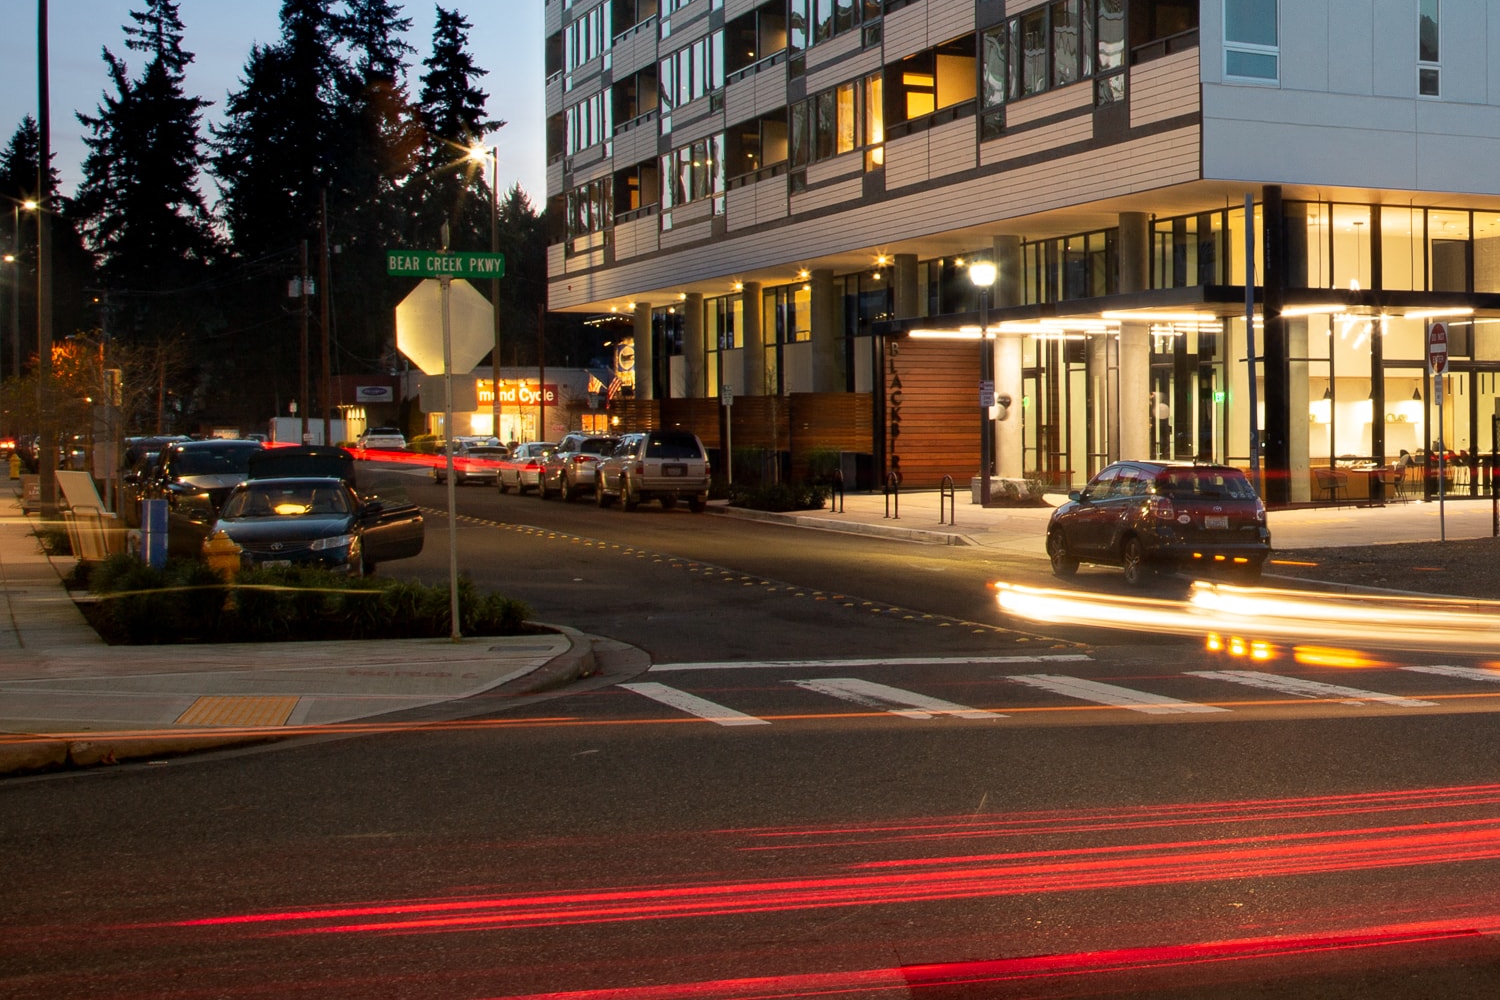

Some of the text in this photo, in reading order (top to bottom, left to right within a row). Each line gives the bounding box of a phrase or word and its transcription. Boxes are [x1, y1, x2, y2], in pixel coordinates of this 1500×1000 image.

[389, 256, 502, 273] BEAR CREEK PKWY
[518, 387, 554, 405] Cycle
